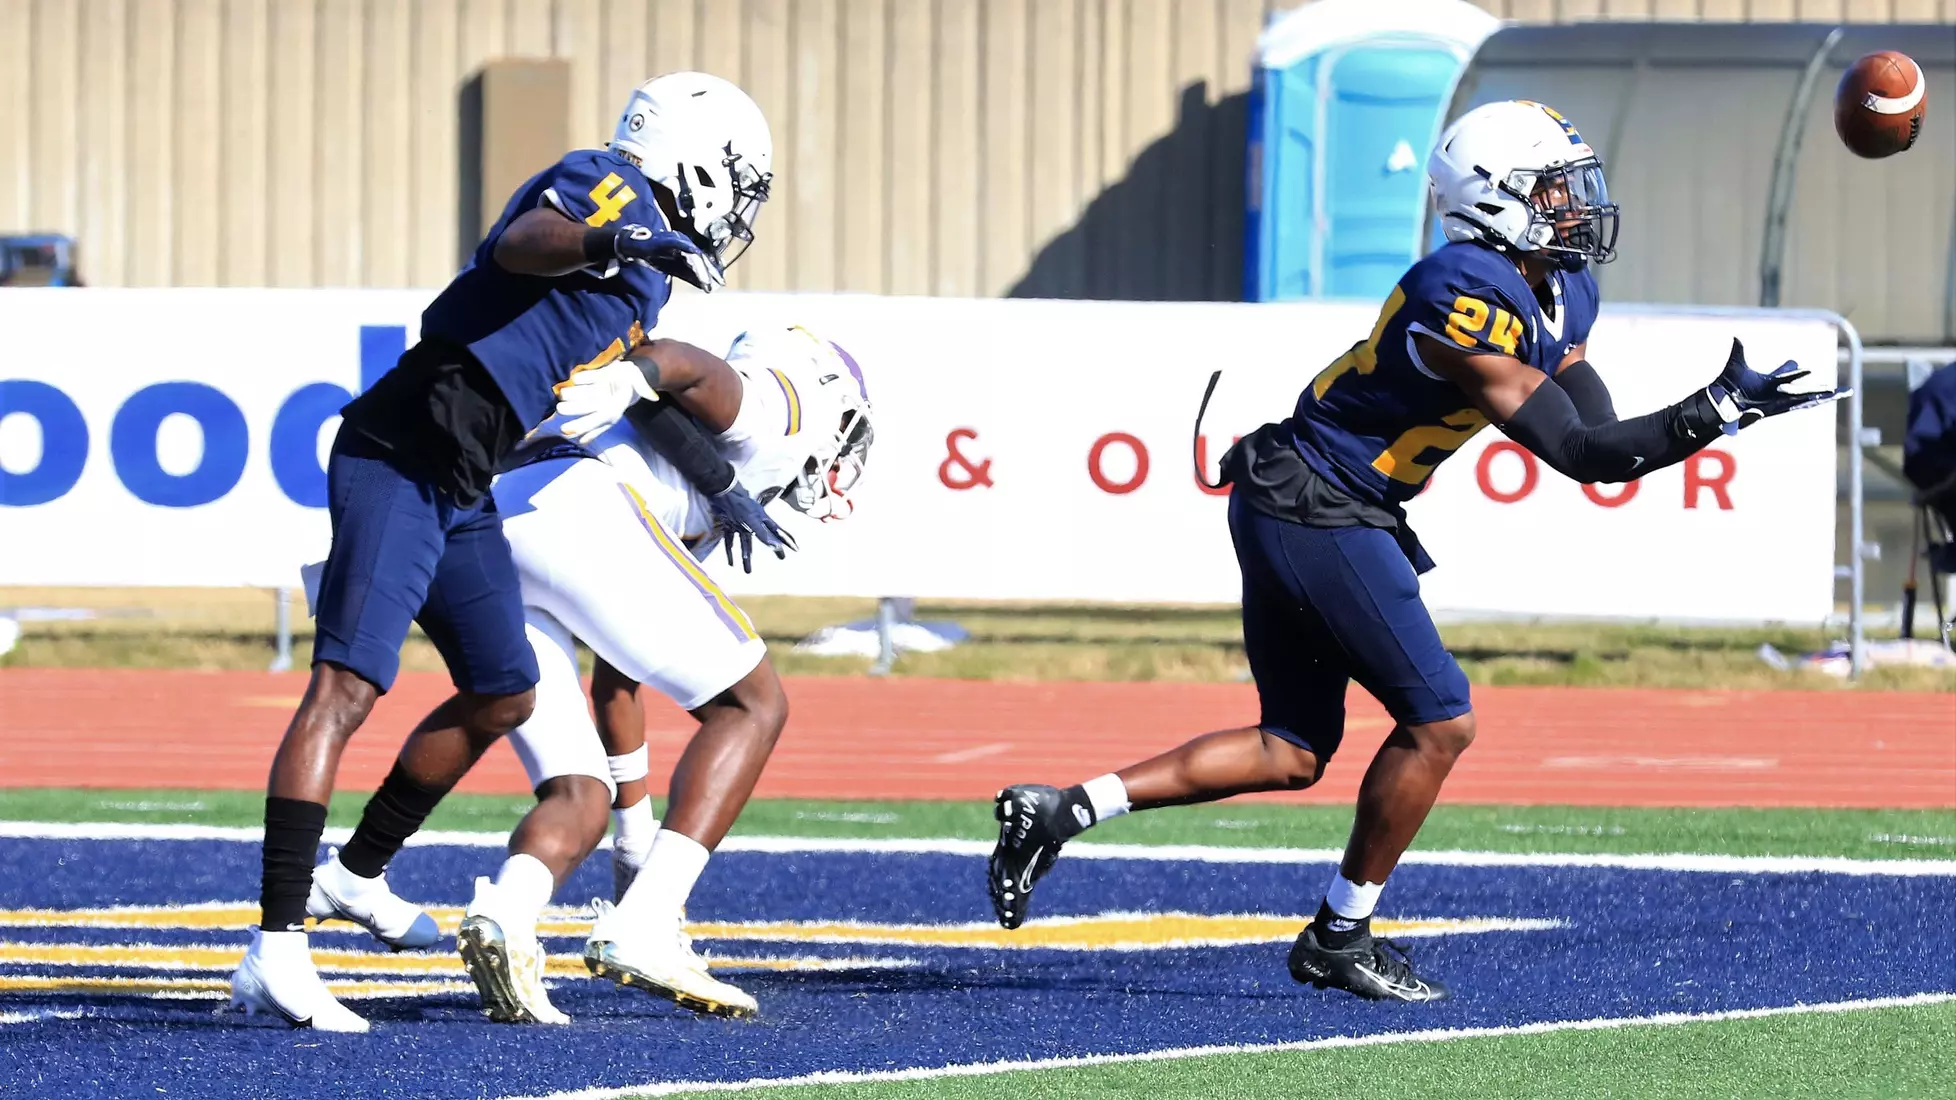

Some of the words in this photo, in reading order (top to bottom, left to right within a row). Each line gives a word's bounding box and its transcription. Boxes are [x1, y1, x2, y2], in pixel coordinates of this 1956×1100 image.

[585, 172, 638, 228] 4
[1445, 296, 1524, 355] 24
[938, 428, 994, 490] &
